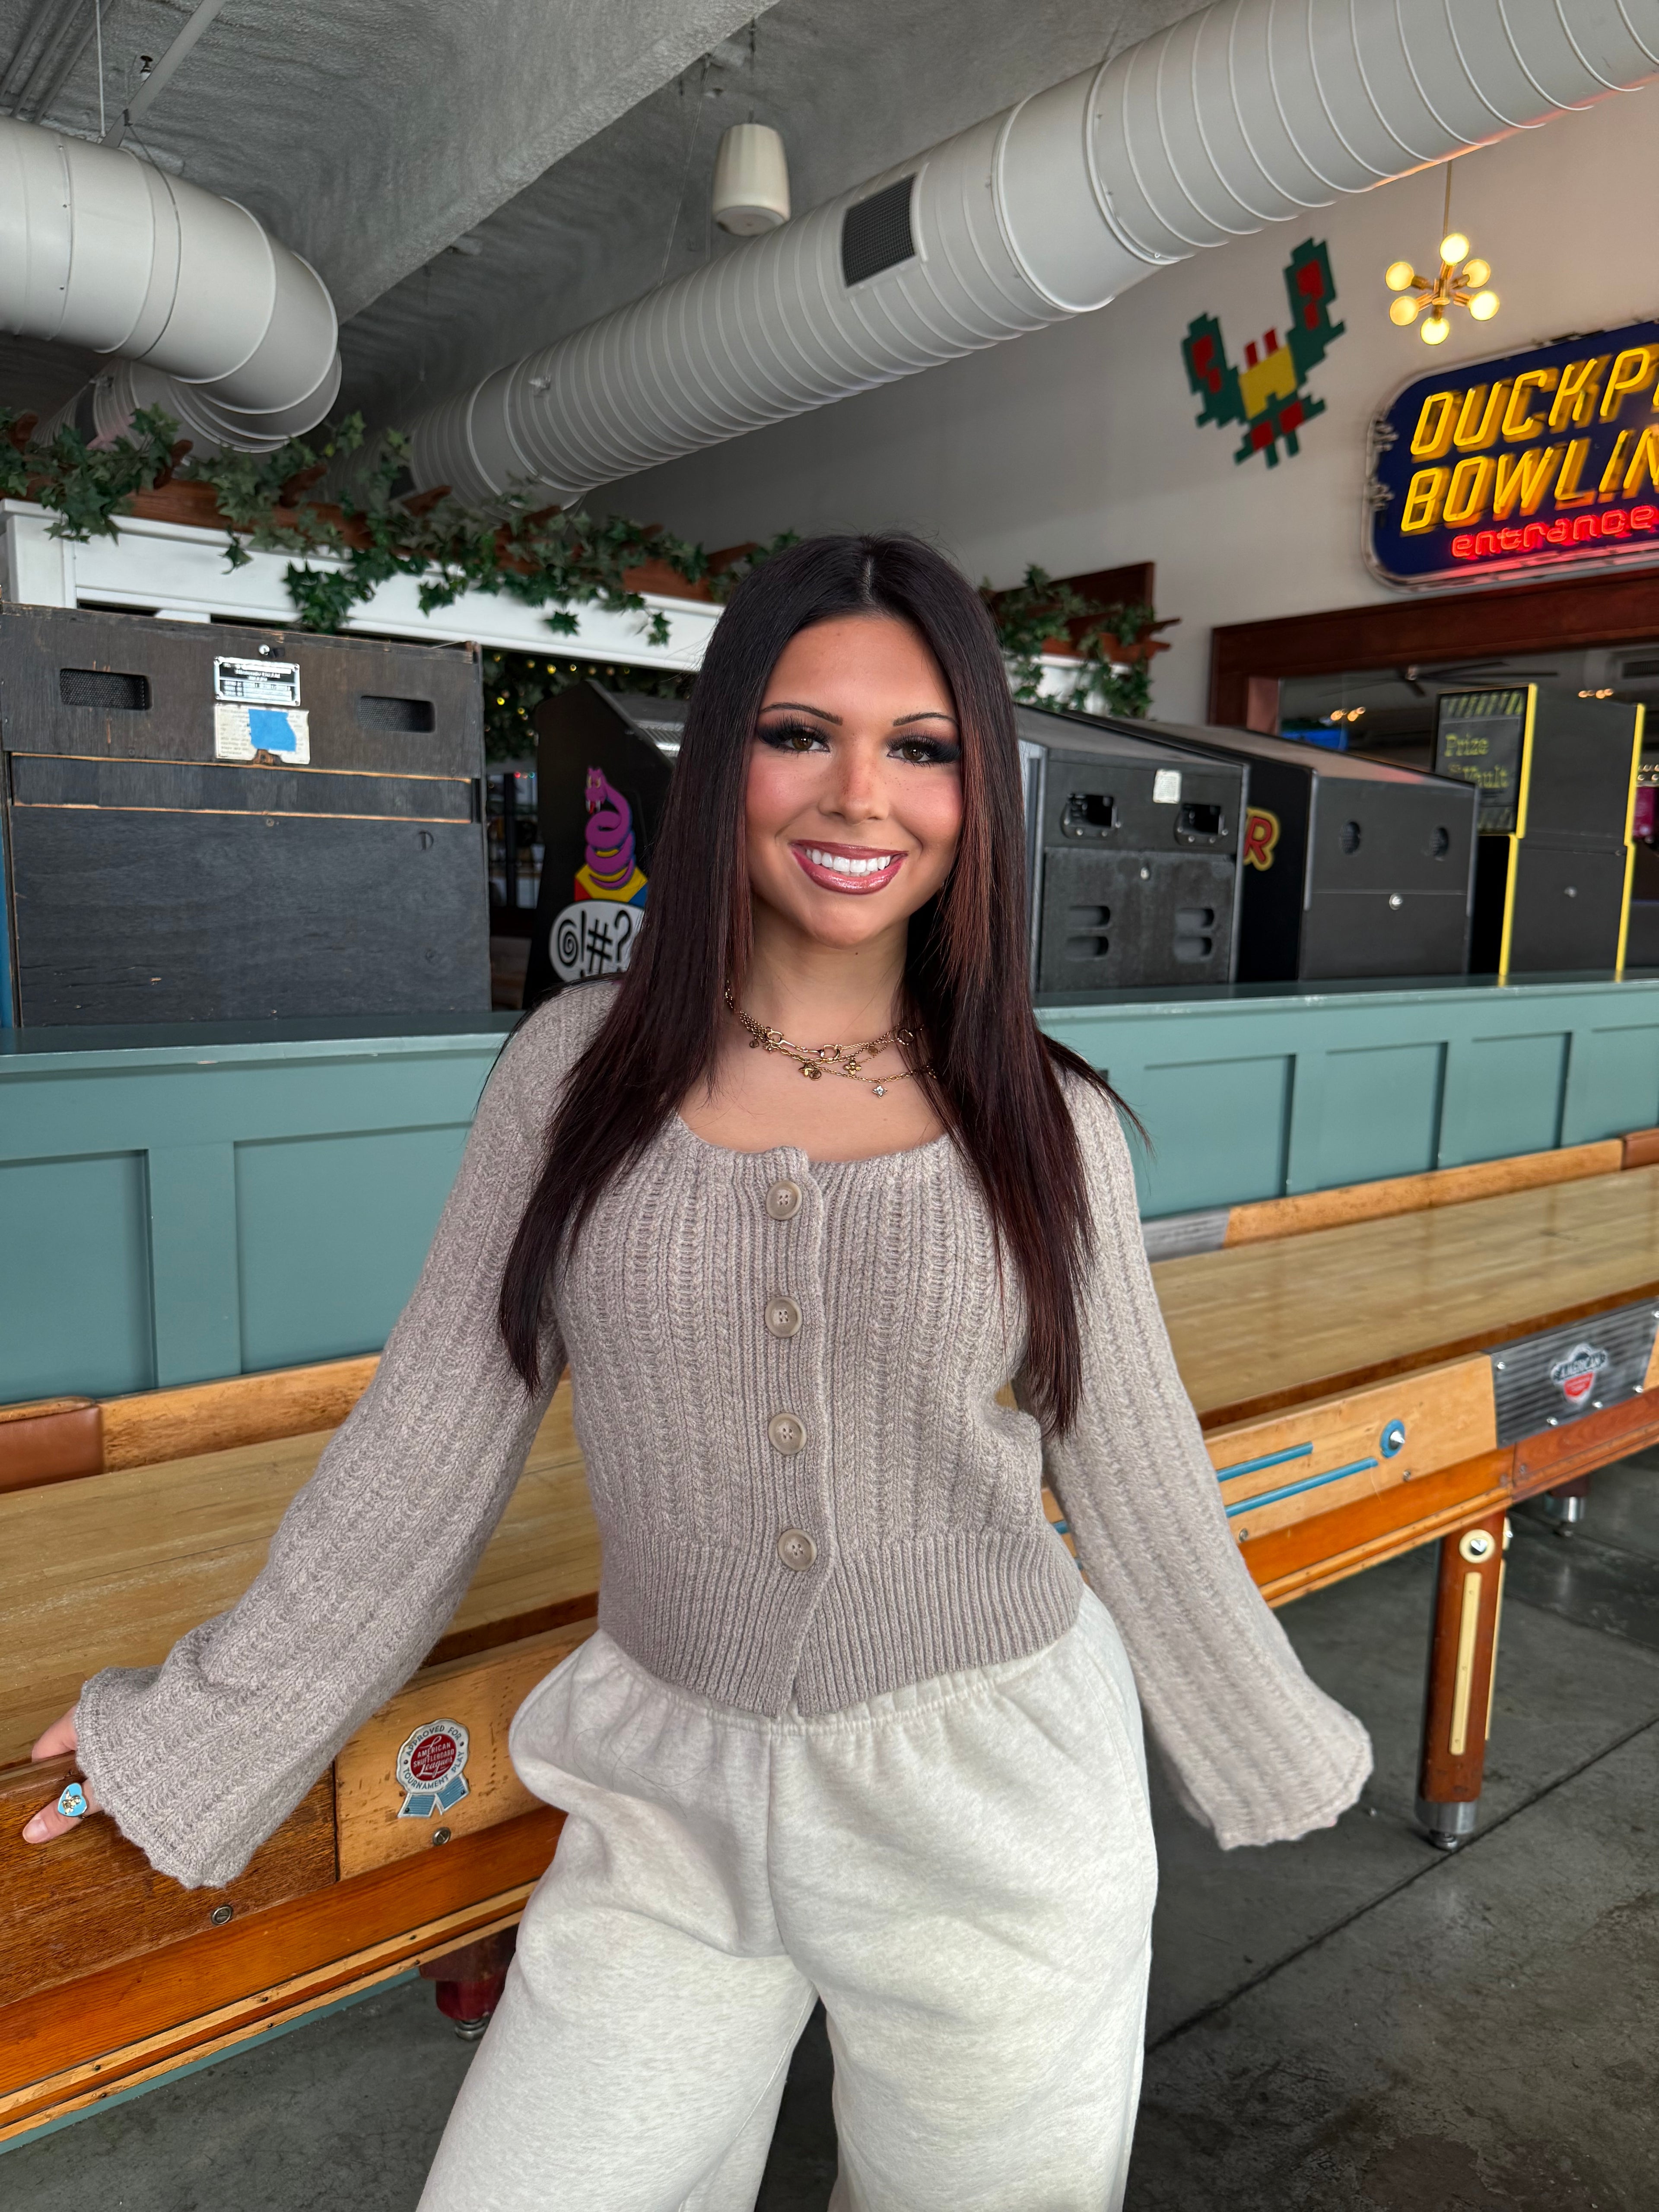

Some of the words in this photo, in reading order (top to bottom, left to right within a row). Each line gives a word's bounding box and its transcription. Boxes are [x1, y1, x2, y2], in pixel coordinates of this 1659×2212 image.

[1410, 343, 1659, 463] DUCKP
[1450, 504, 1658, 560] entrance
[1444, 732, 1489, 757] Prize
[1462, 764, 1510, 788] Vault
[406, 1725, 445, 1756] APPROVED
[448, 1727, 462, 1741] FOR
[417, 1742, 451, 1758] AMERICAN
[403, 1767, 449, 1789] TOURNAMENT
[451, 1751, 464, 1773] PLAY
[413, 1749, 454, 1767] SHUFFLEBOARD
